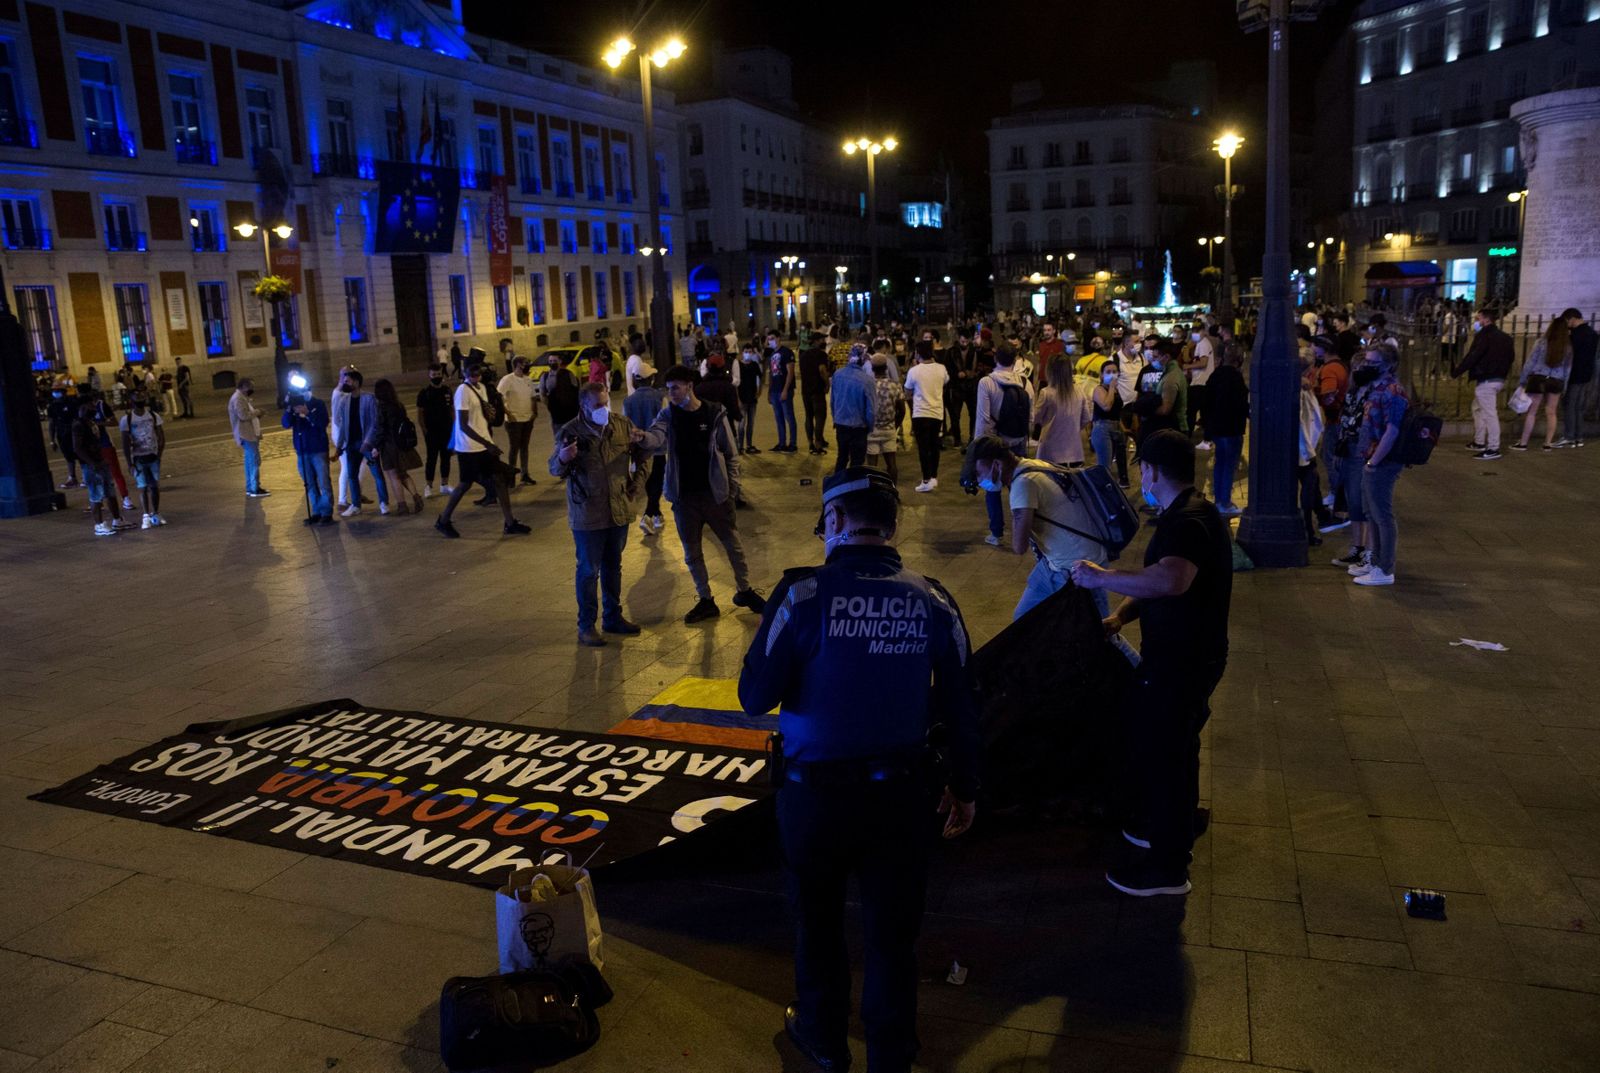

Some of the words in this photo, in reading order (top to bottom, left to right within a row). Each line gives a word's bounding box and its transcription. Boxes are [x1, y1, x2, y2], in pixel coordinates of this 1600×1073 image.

[830, 592, 928, 619] POLICÍA
[828, 619, 928, 638] MUNICIPAL
[868, 640, 927, 654] Madrid
[129, 742, 278, 785] NOS
[464, 754, 666, 803] ESTAN
[257, 759, 610, 845] COLOMBIA
